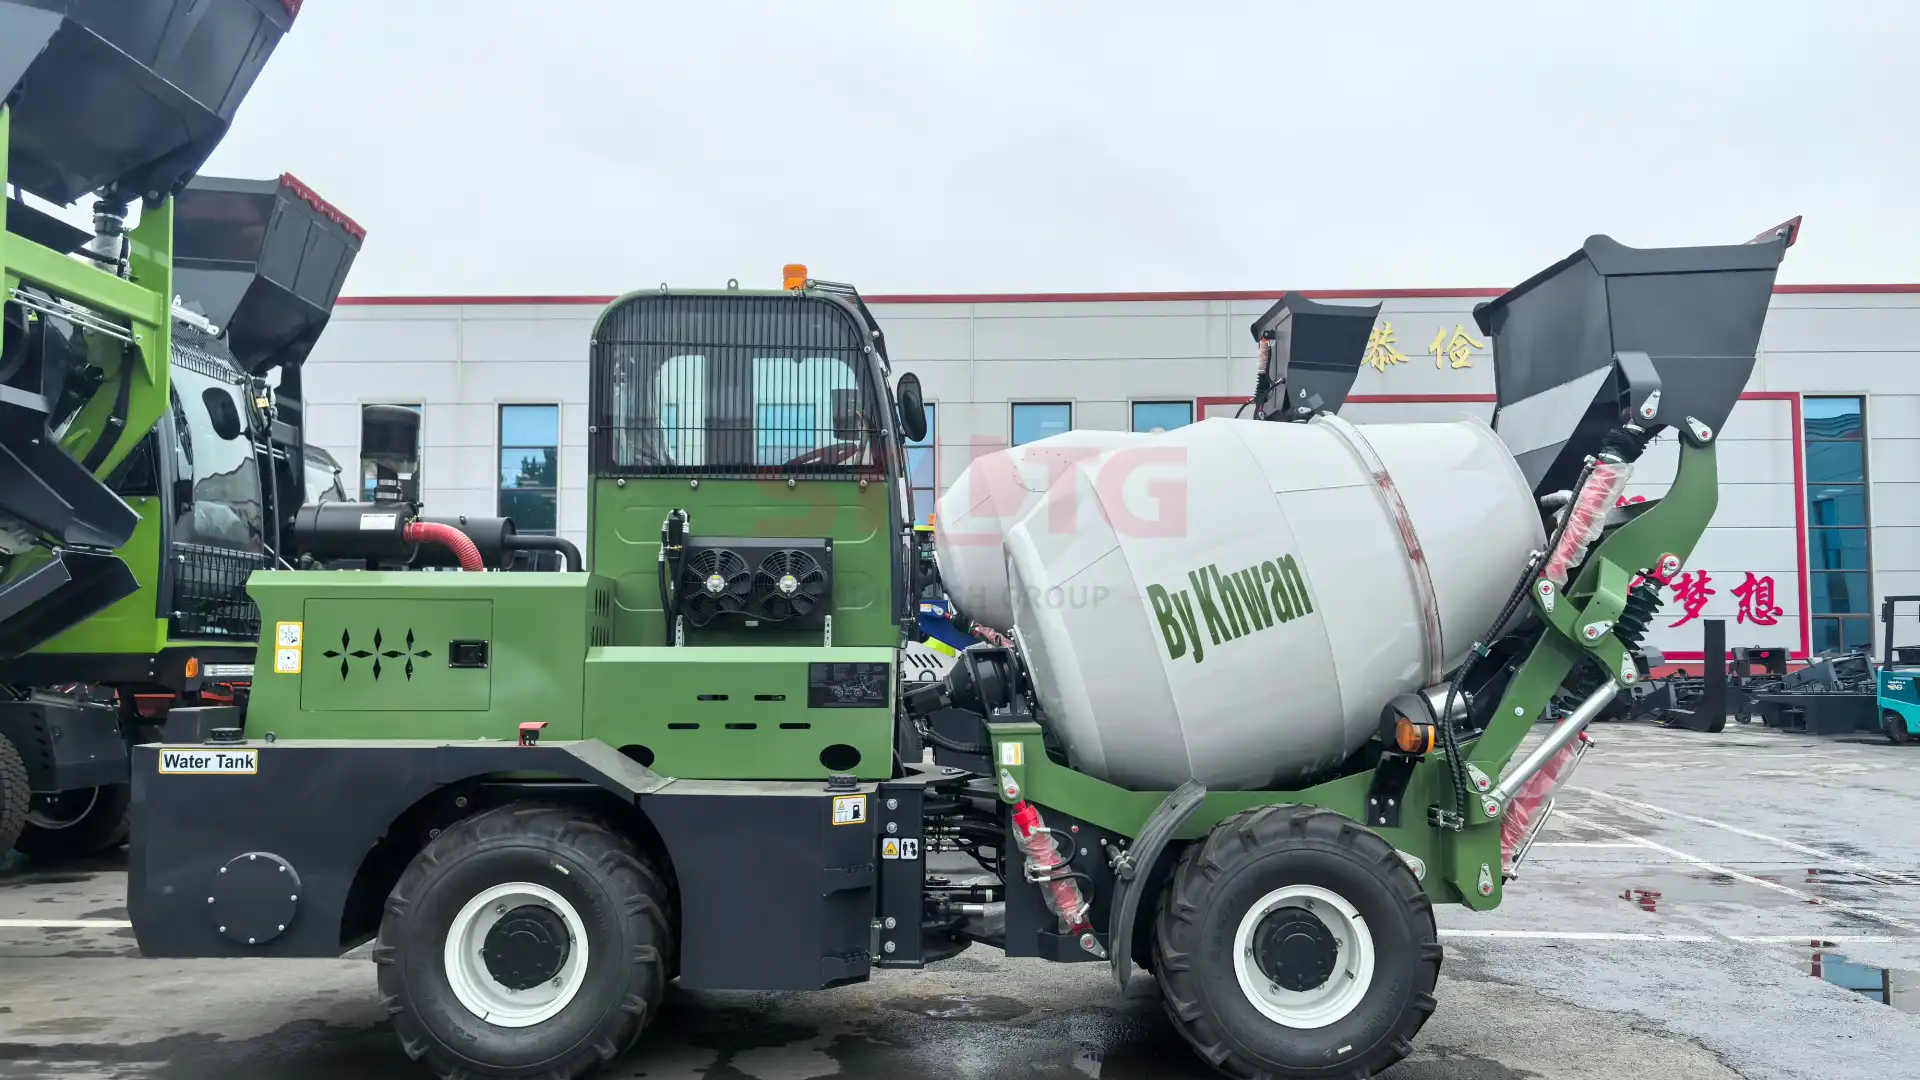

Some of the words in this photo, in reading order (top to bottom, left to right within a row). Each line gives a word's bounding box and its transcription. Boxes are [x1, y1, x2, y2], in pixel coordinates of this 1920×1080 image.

[1146, 583, 1203, 663] By
[1188, 553, 1313, 645] Khwan
[164, 754, 211, 769] Water
[216, 754, 254, 769] Tank
